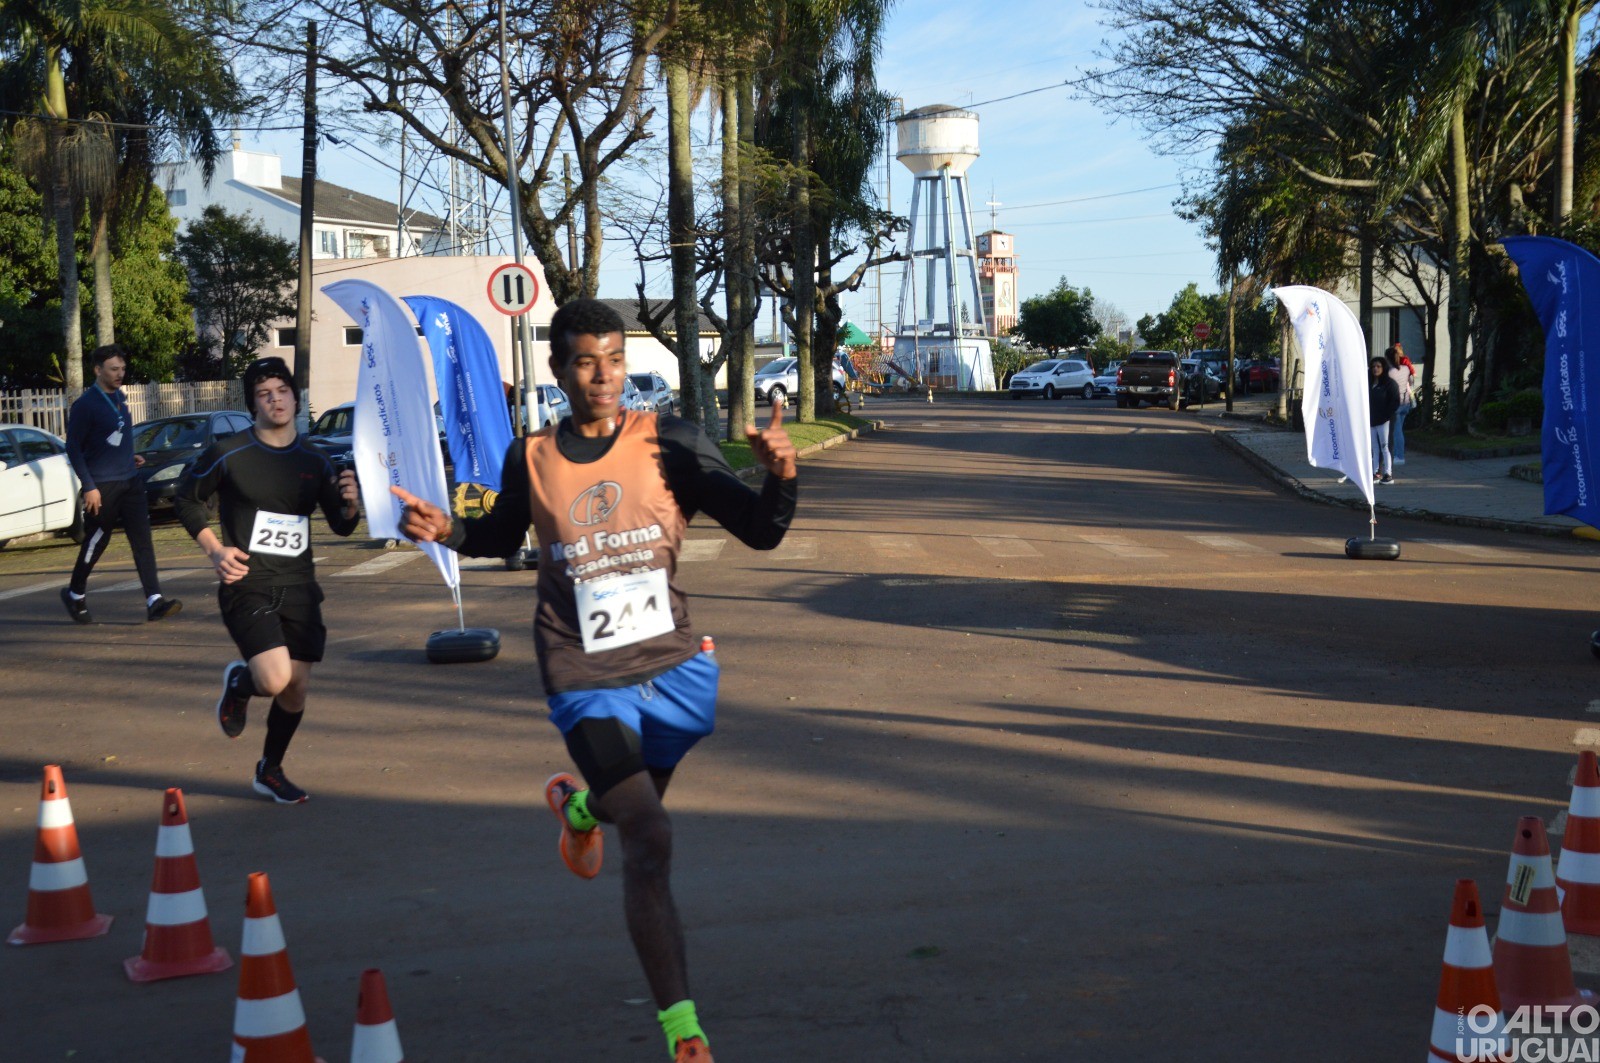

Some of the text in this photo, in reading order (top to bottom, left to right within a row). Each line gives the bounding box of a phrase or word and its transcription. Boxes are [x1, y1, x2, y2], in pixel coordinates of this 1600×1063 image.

[365, 342, 377, 369] Sesc
[457, 374, 468, 412] Sindicatos
[1321, 360, 1331, 397] Sindicatos
[1560, 353, 1573, 410] Sindicatos
[373, 382, 391, 438] Sindicatos
[1568, 426, 1577, 442] RS
[1572, 444, 1587, 507] Fecomércio
[256, 528, 303, 551] 253
[550, 523, 663, 562] Med Forma
